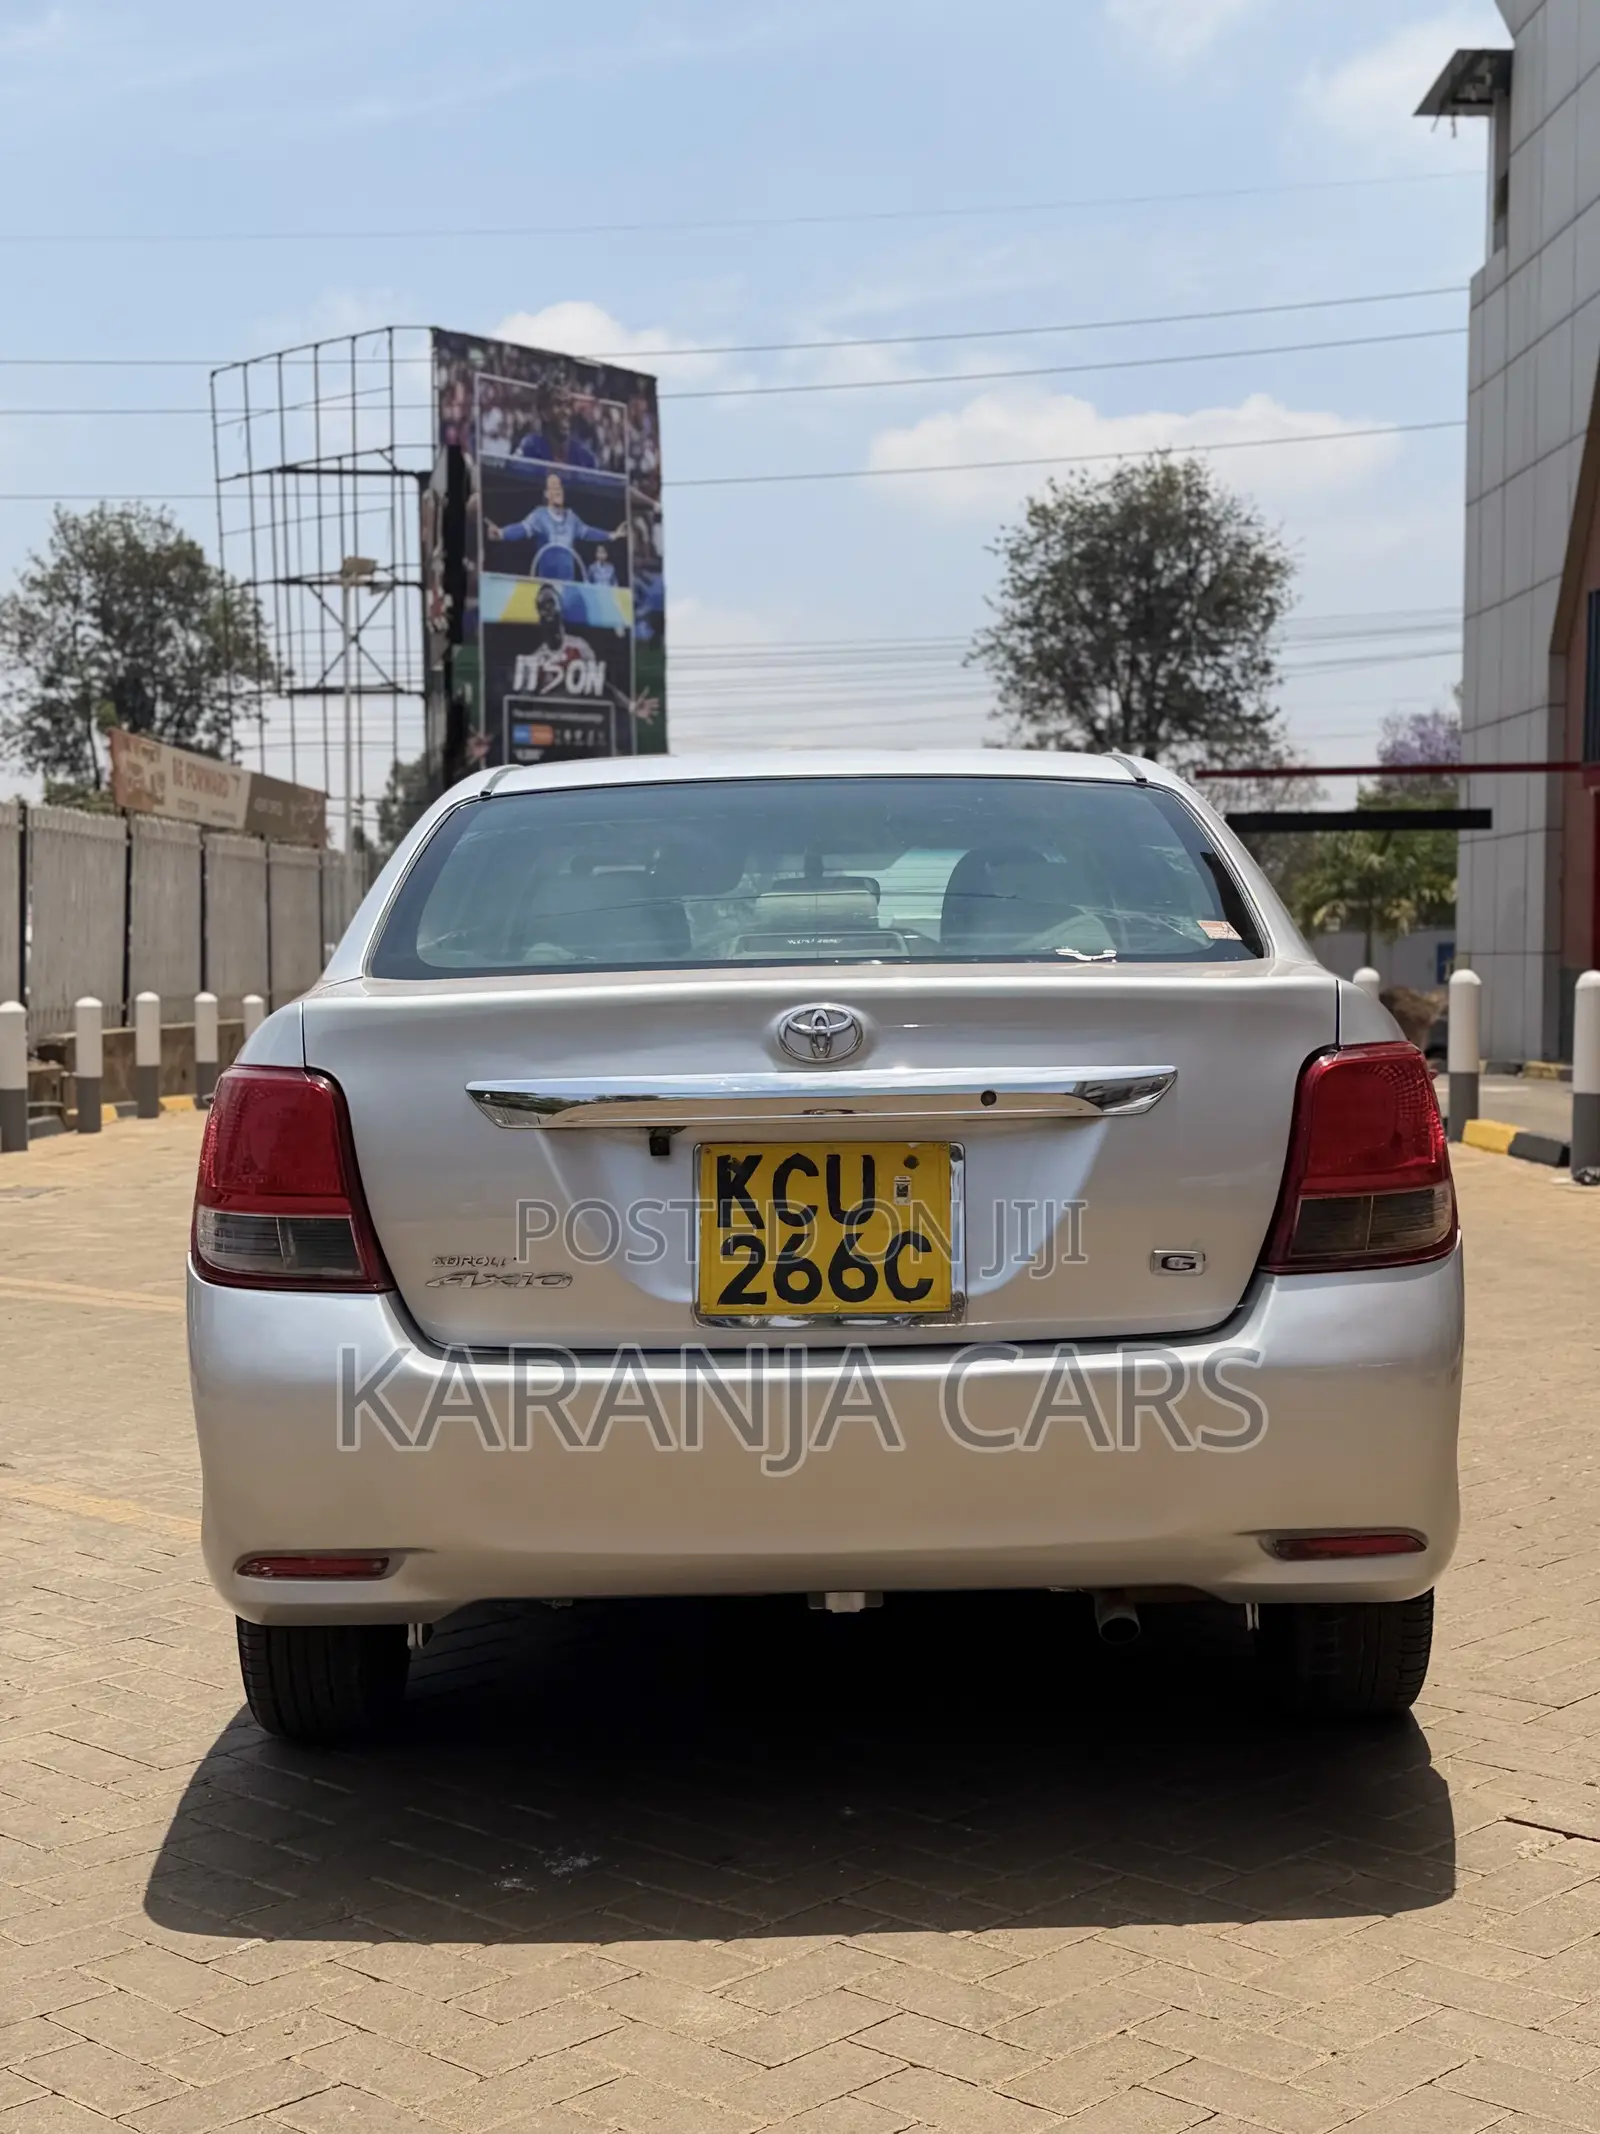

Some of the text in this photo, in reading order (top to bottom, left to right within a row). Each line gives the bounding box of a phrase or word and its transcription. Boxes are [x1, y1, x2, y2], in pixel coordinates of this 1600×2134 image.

[565, 659, 606, 696] ON
[717, 1152, 876, 1229] KCU
[425, 1270, 573, 1288] AXIO
[717, 1230, 934, 1306] 266C
[1161, 1255, 1196, 1271] G
